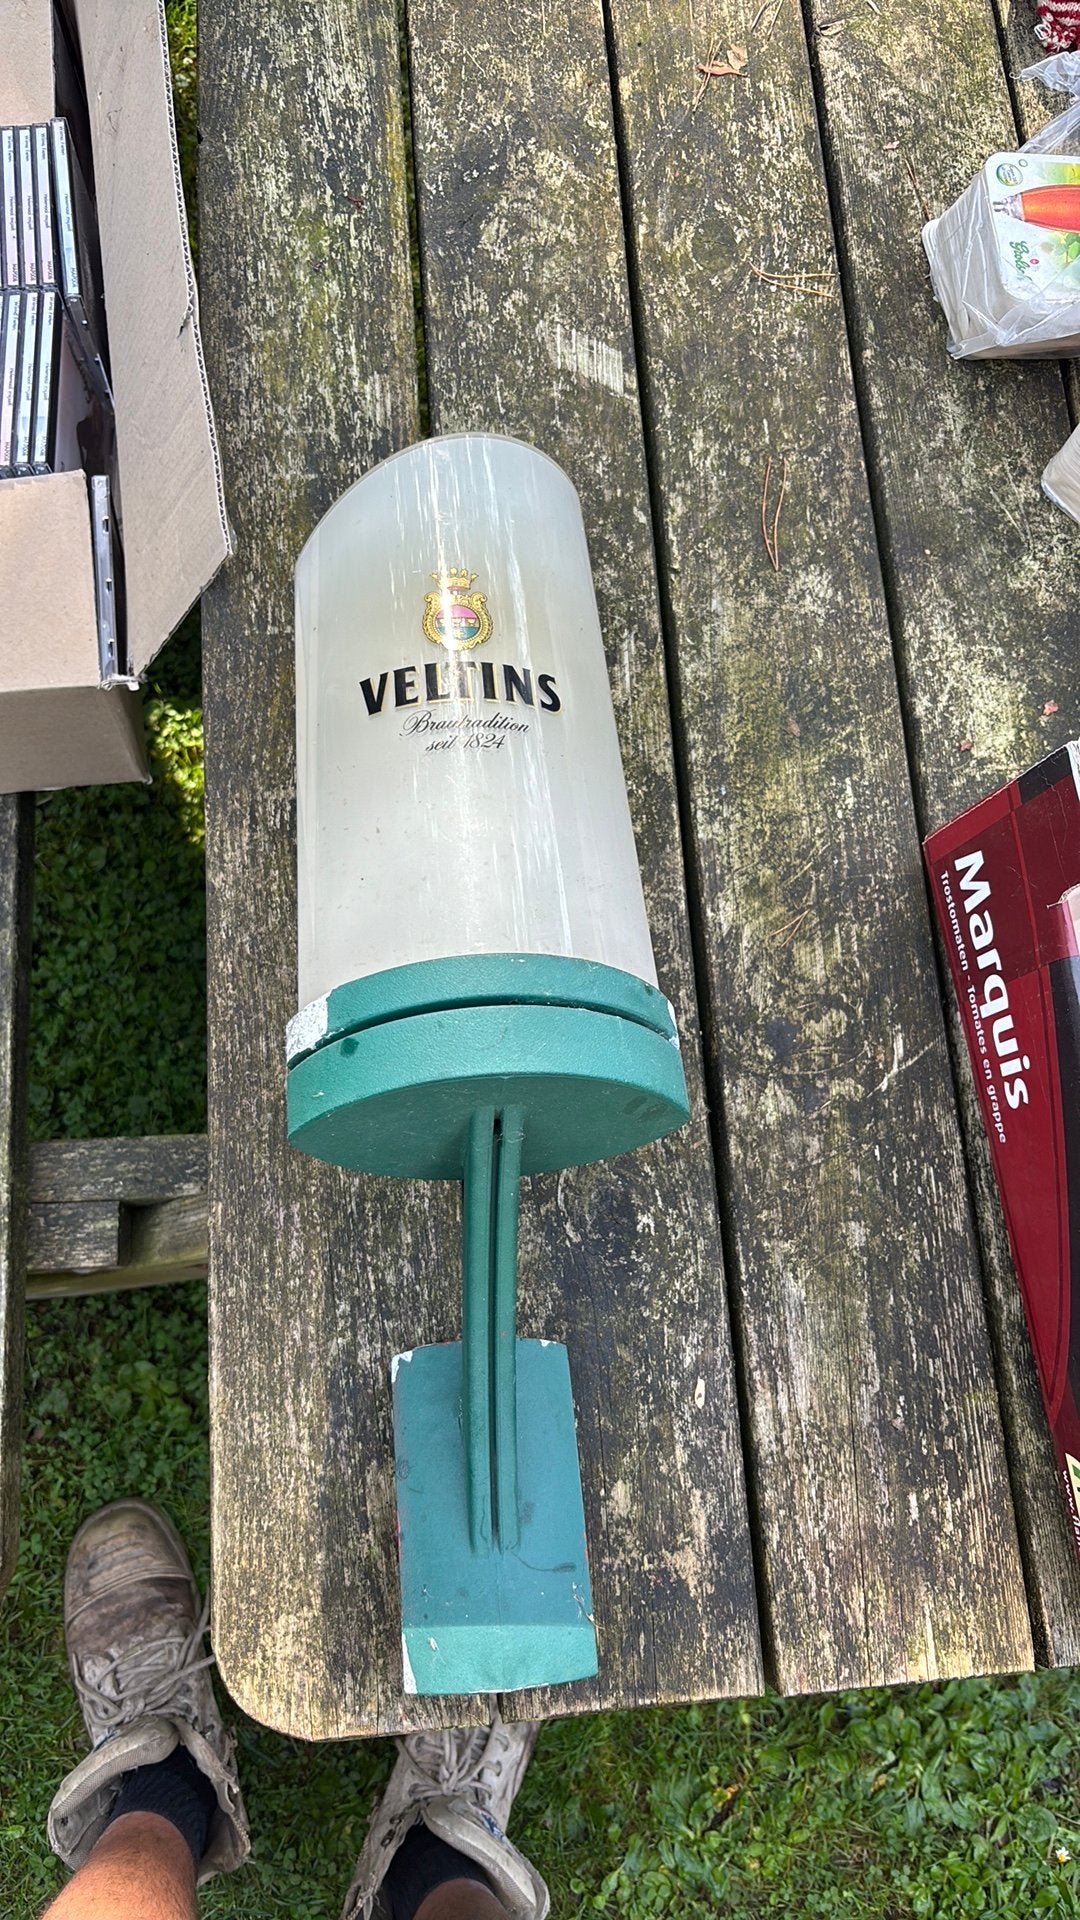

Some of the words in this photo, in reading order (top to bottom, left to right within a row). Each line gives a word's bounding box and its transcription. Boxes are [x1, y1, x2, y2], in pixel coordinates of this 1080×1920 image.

[359, 661, 562, 716] VELTINS
[399, 708, 530, 737] Brautradition
[425, 735, 457, 752] seit
[463, 733, 505, 749] 1824
[940, 870, 969, 972] Trostomaten
[954, 850, 1031, 1110] Marquis
[967, 985, 988, 1055] Tomates
[982, 1058, 993, 1080] en
[986, 1083, 1007, 1144] grappe
